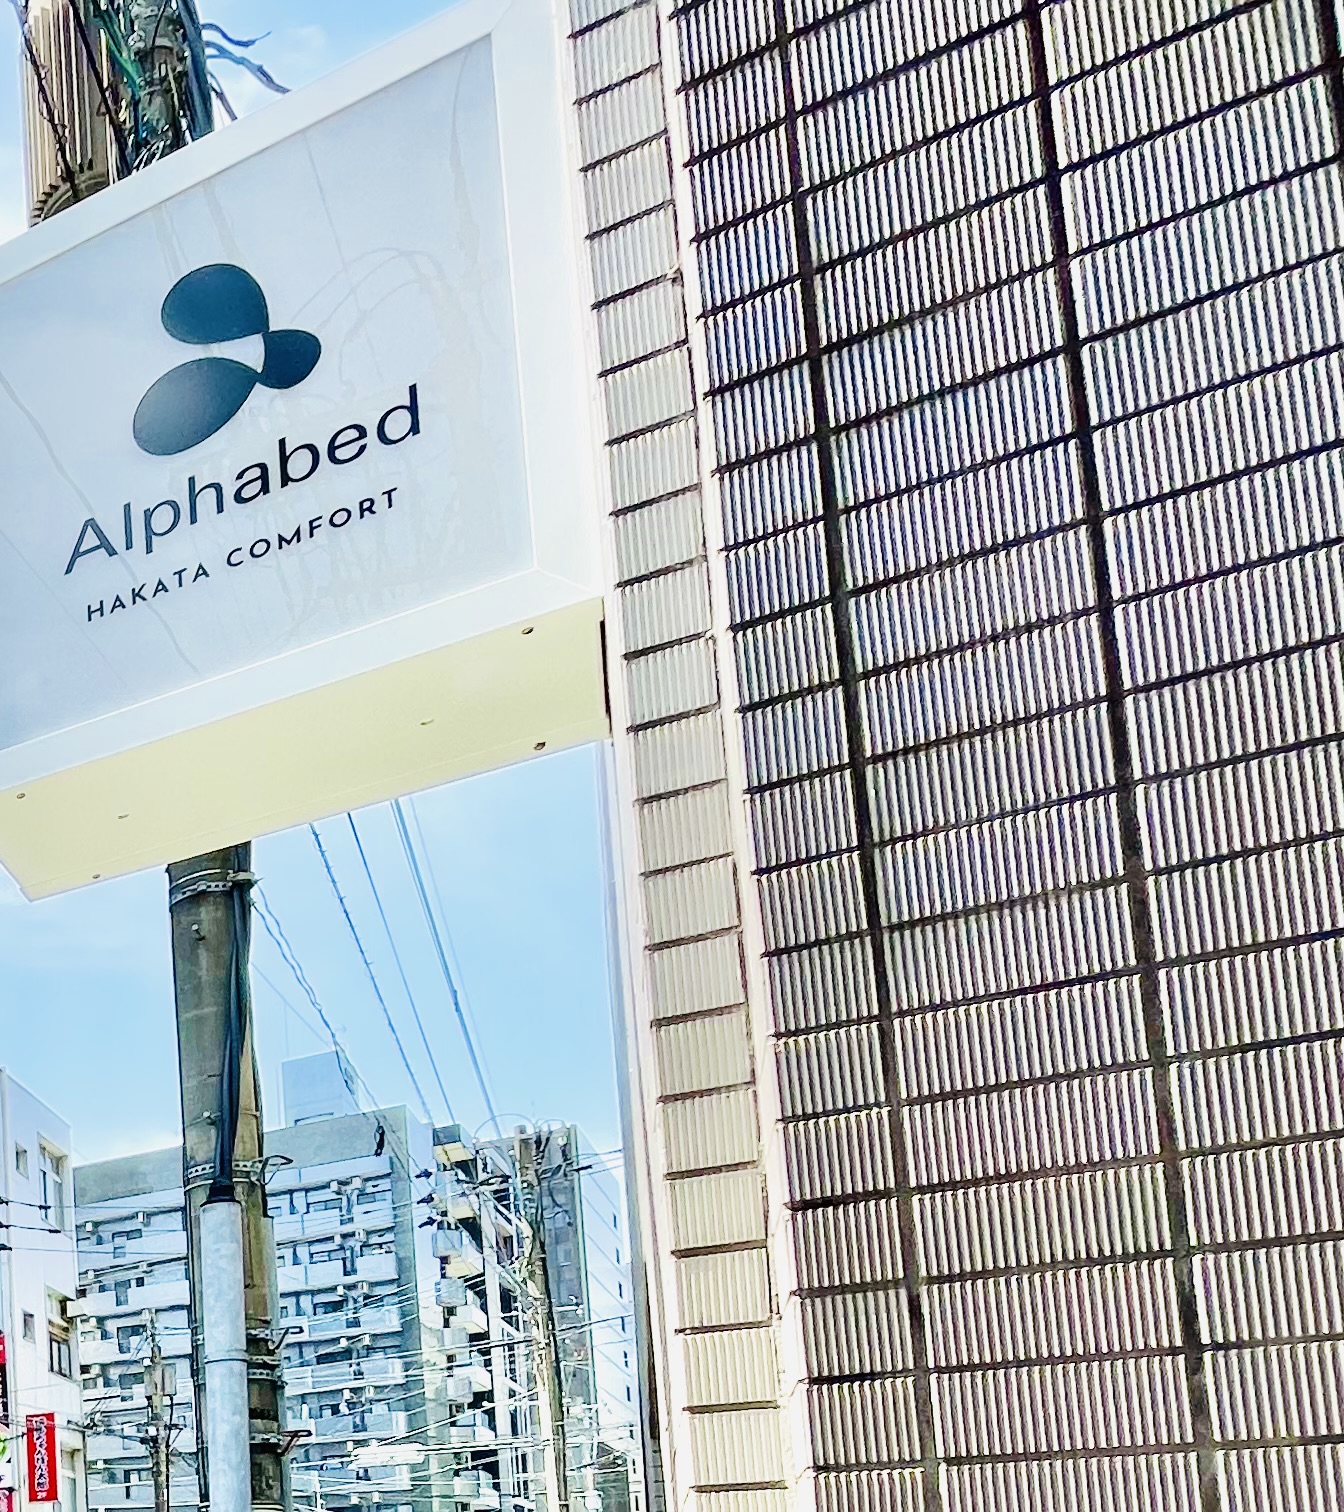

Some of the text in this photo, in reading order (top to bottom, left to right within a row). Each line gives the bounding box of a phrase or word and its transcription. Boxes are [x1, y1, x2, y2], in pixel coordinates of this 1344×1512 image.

[64, 383, 421, 576] Alphabed
[86, 487, 399, 622] HAKATA COMFORT
